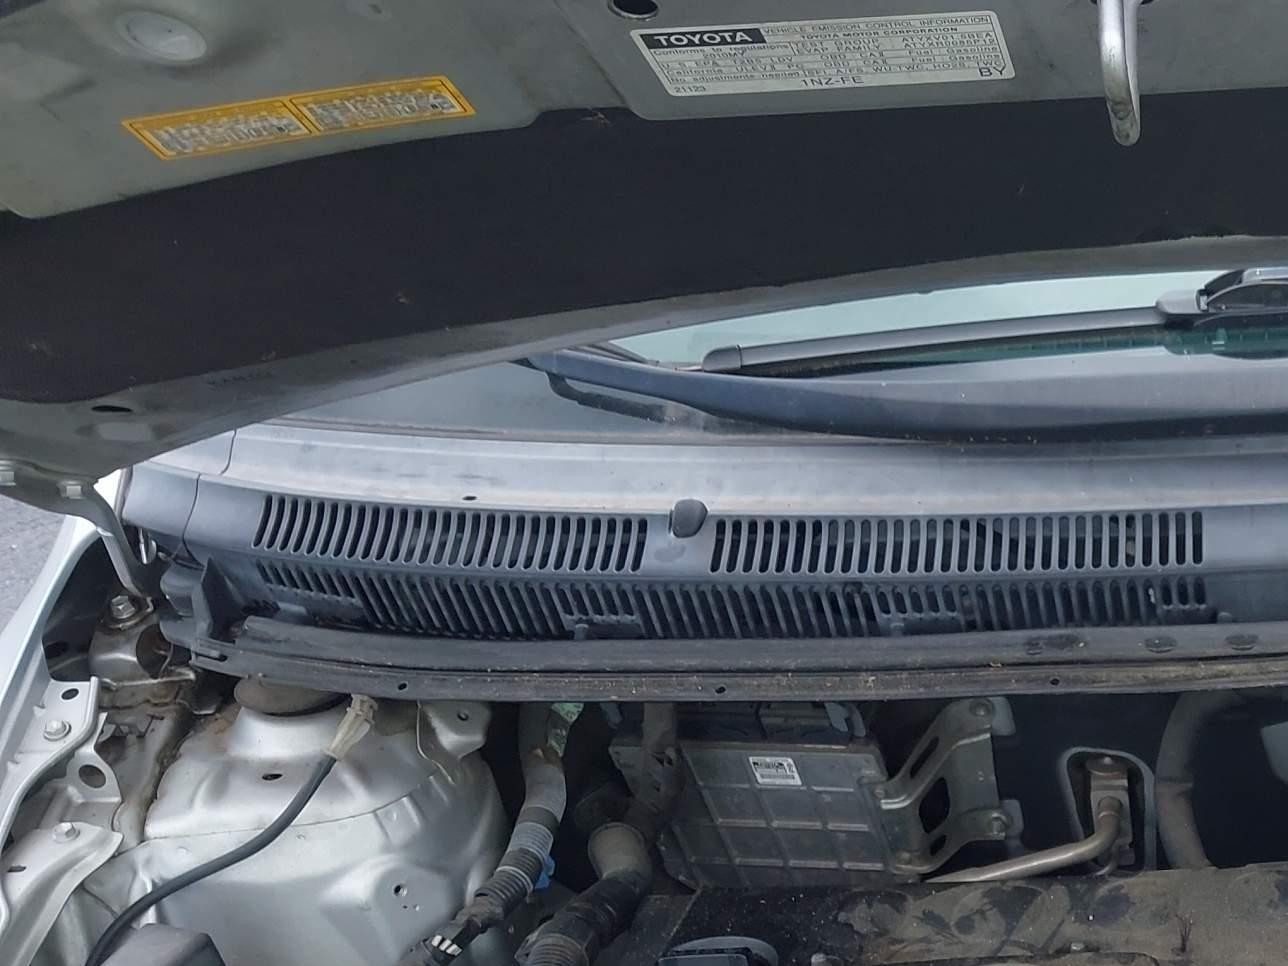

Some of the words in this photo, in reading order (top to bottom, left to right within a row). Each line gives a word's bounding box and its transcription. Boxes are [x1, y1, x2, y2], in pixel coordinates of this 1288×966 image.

[811, 23, 861, 32] EMISSION
[866, 20, 915, 29] CONTROL
[919, 15, 990, 26] INFORMATION
[883, 27, 958, 35] CORPORATION
[653, 31, 753, 47] TOYOTA
[653, 48, 706, 56] Conforms
[667, 68, 723, 76] California
[978, 64, 1008, 77] BY
[801, 76, 865, 87] 1NZ-FE
